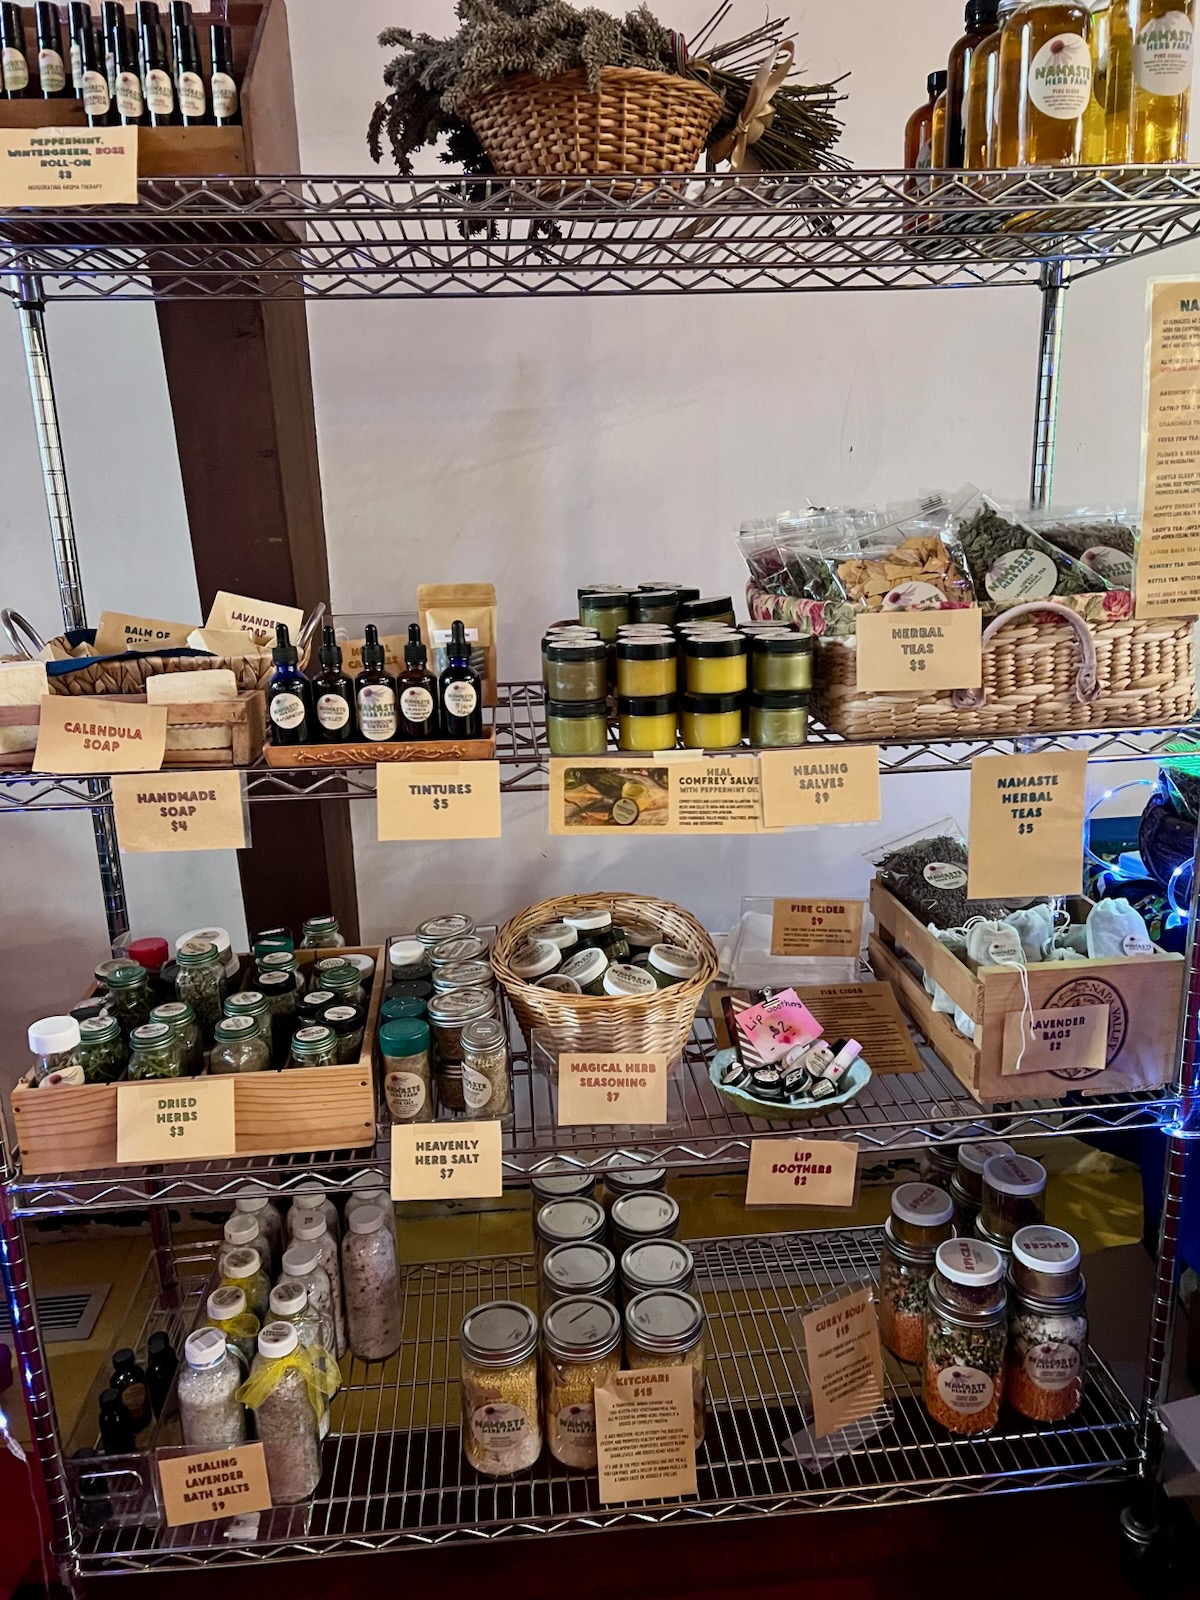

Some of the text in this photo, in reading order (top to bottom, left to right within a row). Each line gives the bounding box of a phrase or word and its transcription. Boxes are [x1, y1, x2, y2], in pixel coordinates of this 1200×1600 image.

[1045, 77, 1068, 86] HERB
[58, 170, 72, 179] $3
[124, 626, 170, 640] BALM OF
[893, 626, 945, 640] HERBAL
[902, 644, 935, 656] TEAS
[911, 659, 927, 672] $5
[64, 722, 144, 740] CALENDULA
[84, 739, 120, 752] SOAP
[707, 768, 732, 776] HEAL
[794, 763, 848, 776] HEALING
[800, 778, 844, 790] SALVES
[997, 776, 1058, 789] NAMASTE
[408, 784, 473, 795] TINTURES
[137, 790, 218, 804] HANDMADE
[815, 792, 830, 804] $9
[1002, 792, 1052, 804] HERBAL
[433, 798, 450, 810] $5
[160, 806, 198, 818] SOAP
[1011, 808, 1042, 819] TEAS
[171, 820, 189, 832] $4
[1018, 823, 1034, 834] $5
[791, 904, 845, 914] FIRE CIDER
[812, 916, 824, 926] $9
[745, 1014, 764, 1031] Lip
[1089, 983, 1115, 1006] NAPA
[1108, 1008, 1122, 1051] VALLEY
[1043, 1030, 1071, 1040] BAGS
[1050, 1042, 1062, 1052] $2
[570, 1063, 656, 1073] MAGICAL HERB
[580, 1078, 647, 1088] SEASONING
[606, 1092, 620, 1102] $7
[158, 1098, 197, 1109] DRIED
[156, 1112, 198, 1123] HERBS
[170, 1126, 184, 1138] $3
[416, 1140, 479, 1151] HEAVENLY
[416, 1154, 480, 1166] HERB SALT
[794, 1152, 812, 1162] LIP
[440, 1168, 454, 1180] $7
[772, 1164, 832, 1174] SOOTHERS
[1023, 1242, 1069, 1250] SPICES
[816, 1303, 866, 1333] CURRY SOUP
[616, 1374, 670, 1386] KITCHARI
[945, 1382, 986, 1390] NAMASTE
[475, 1418, 525, 1428] NAMASTE
[188, 1458, 238, 1474] HEALING
[186, 1470, 244, 1488] LAVENDER
[183, 1483, 250, 1502] BATH SALTS
[212, 1501, 226, 1512] $9
